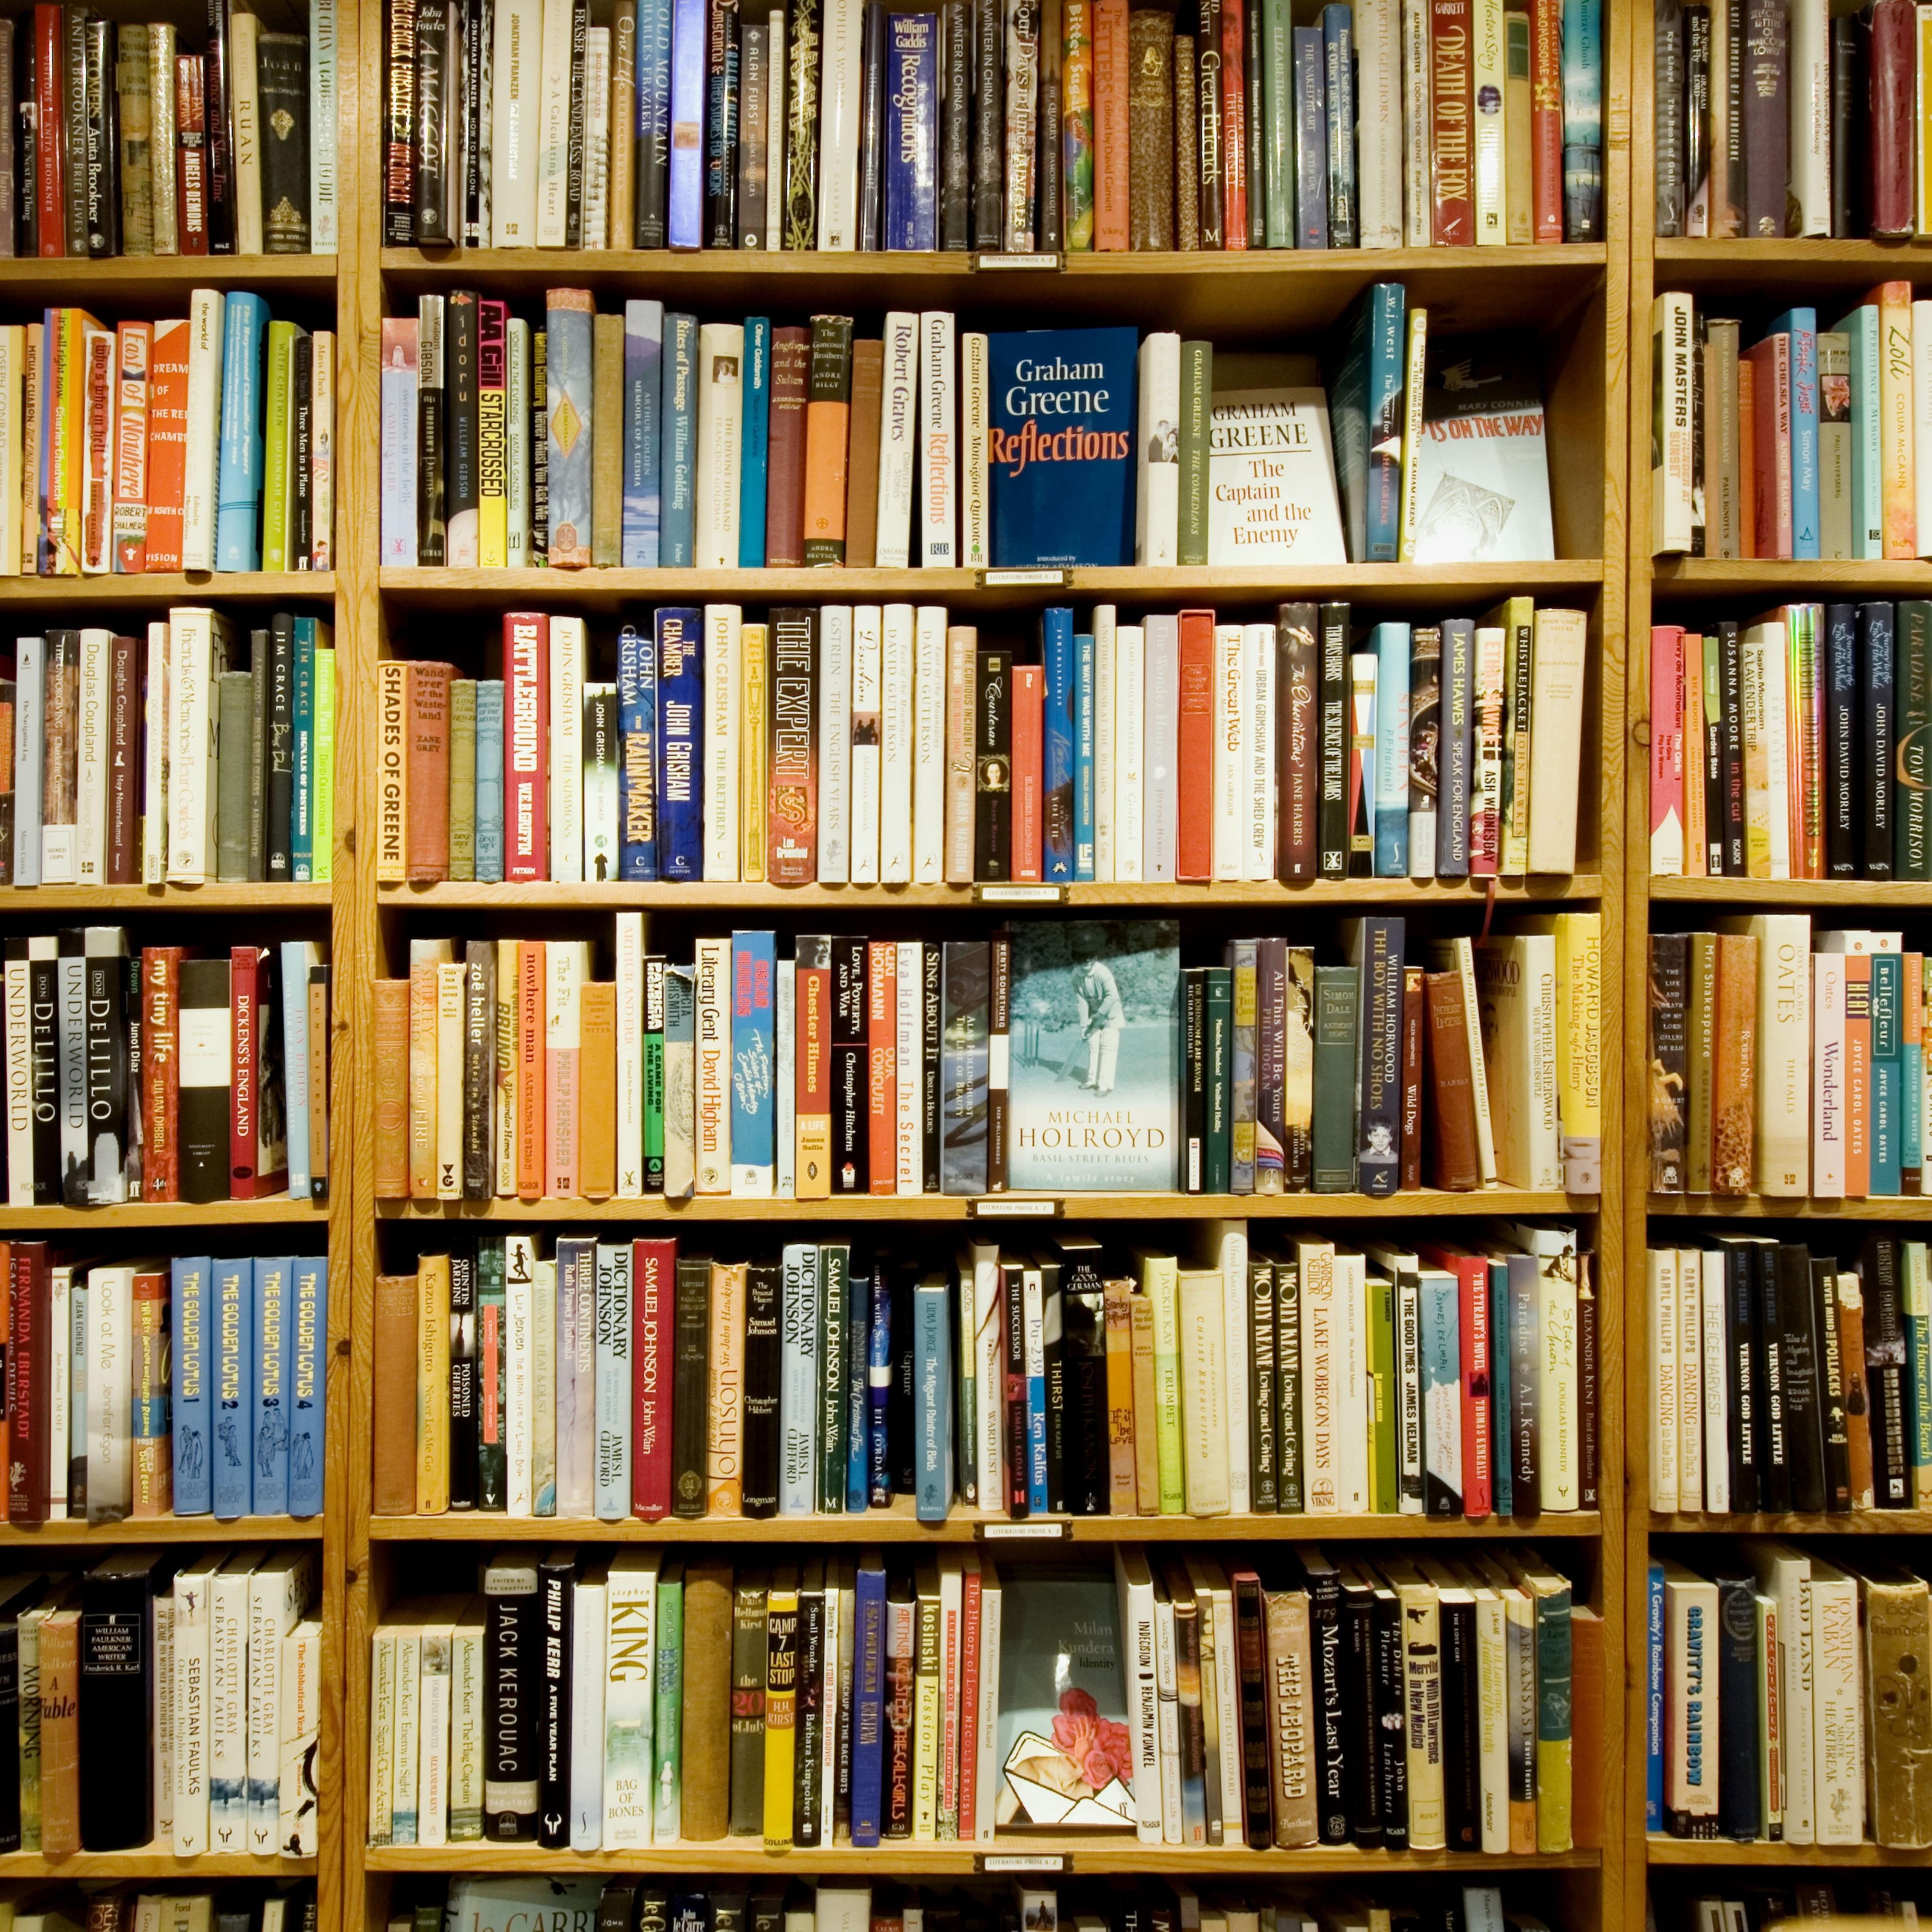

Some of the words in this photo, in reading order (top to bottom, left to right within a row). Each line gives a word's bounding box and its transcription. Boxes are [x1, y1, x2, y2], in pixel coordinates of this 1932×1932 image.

[511, 14, 520, 63] JONATHAN
[894, 22, 929, 35] William
[895, 36, 927, 48] Gaddis
[1069, 4, 1083, 58] Bitter
[1435, 25, 1466, 96] DEATH
[511, 64, 519, 100] FRANZEN
[1069, 64, 1084, 113] Sugar
[1201, 50, 1221, 110] Great
[1436, 102, 1466, 124] OF
[89, 127, 97, 162] Anita
[239, 100, 252, 166] RUAN
[1201, 113, 1221, 185] Friends
[1436, 125, 1467, 157] THE
[184, 151, 200, 187] ANGELS
[1437, 162, 1467, 202] FOX
[89, 164, 102, 223] Brookner
[187, 190, 201, 233] DEMONS
[675, 319, 688, 348] Rites
[1674, 306, 1687, 348] JOHN
[124, 332, 145, 370] East
[676, 349, 688, 361] of
[894, 323, 913, 385] Robert
[1015, 357, 1104, 382] Graham
[123, 384, 144, 407] of
[673, 363, 688, 412] Passage
[1006, 386, 1110, 416] Greene
[1674, 353, 1687, 427] MASTERS
[299, 407, 307, 433] Three
[892, 387, 910, 441] Graves
[1212, 403, 1297, 421] GRAHAM
[481, 393, 503, 498] STARCROSSED
[675, 415, 688, 462] William
[988, 419, 1130, 477] Reflections
[1209, 423, 1308, 449] GREENE
[121, 418, 144, 498] Nowhere
[299, 455, 306, 464] in
[1248, 459, 1284, 478] The
[673, 465, 688, 510] Golding
[1216, 484, 1280, 506] Captain
[114, 521, 146, 532] CHALMERS
[115, 507, 145, 518] ROBERT
[1247, 504, 1279, 523] and
[1283, 503, 1311, 521] the
[1234, 527, 1298, 547] Enemy
[145, 552, 178, 562] VISION
[276, 631, 285, 657] JIM
[682, 640, 695, 657] THE
[777, 617, 811, 672] THE
[1227, 633, 1241, 664] The
[1452, 632, 1466, 675] JAMES
[1727, 631, 1736, 694] SUSANNA
[86, 643, 99, 697] Douglas
[275, 664, 285, 712] CRACE
[1255, 670, 1266, 697] URBAN
[384, 667, 400, 746] SHADES
[513, 624, 538, 772] BATTLEGROUND
[1227, 668, 1241, 714] Great
[1452, 678, 1465, 726] HAWES
[86, 700, 99, 762] Coupland
[666, 700, 690, 736] JOHN
[775, 677, 809, 779] EXPERT
[1227, 717, 1241, 752] Web
[1255, 699, 1266, 753] GRIMSHAW
[1729, 703, 1739, 750] MOORE
[384, 752, 400, 777] OF
[416, 744, 441, 752] GREY
[1255, 756, 1265, 775] AND
[1452, 741, 1464, 776] SPEAK
[1909, 746, 1923, 783] TONI
[666, 742, 692, 802] GRISHAM
[1254, 779, 1265, 794] THE
[1452, 779, 1463, 799] FOR
[384, 784, 399, 860] GREENE
[1254, 797, 1265, 820] SHED
[1253, 823, 1264, 848] CREW
[1452, 801, 1463, 862] ENGLAND
[1909, 789, 1924, 870] MORRISON
[150, 960, 166, 987] my
[525, 953, 536, 1024] nowhere
[699, 946, 720, 1004] Literary
[1777, 943, 1796, 1024] OATES
[150, 991, 169, 1026] tiny
[702, 1007, 720, 1042] Gent
[808, 976, 821, 1038] Chester
[9, 968, 29, 1132] UNDERWORLD
[157, 1031, 174, 1063] life
[525, 1029, 535, 1064] man
[702, 1050, 720, 1092] David
[808, 1042, 821, 1093] Himes
[1407, 1084, 1417, 1109] Wild
[1823, 1040, 1839, 1142] Wonderland
[700, 1094, 721, 1152] Higham
[1049, 1110, 1135, 1123] MICHAEL
[1404, 1111, 1416, 1136] Dogs
[1019, 1128, 1165, 1148] HOLROYD
[1033, 1154, 1064, 1163] BASIL
[1069, 1154, 1110, 1163] STREET
[1115, 1154, 1149, 1163] BLUES
[183, 1272, 200, 1299] THE
[452, 1259, 461, 1306] JARDINE
[461, 1259, 469, 1305] QUINTIN
[1067, 1282, 1101, 1291] GERMAN
[1072, 1273, 1097, 1283] GOOD
[1077, 1264, 1091, 1274] THE
[102, 1280, 116, 1317] Look
[1403, 1298, 1414, 1319] THE
[102, 1323, 116, 1335] at
[183, 1301, 200, 1351] GOLDEN
[1404, 1322, 1414, 1347] GOOD
[101, 1343, 115, 1370] Me
[183, 1352, 200, 1397] LOTUS
[1406, 1350, 1414, 1374] TIMES
[1740, 1343, 1751, 1391] VERNON
[453, 1365, 461, 1417] CHERRIES
[462, 1363, 470, 1418] POISONED
[1406, 1383, 1416, 1418] JAMES
[1741, 1395, 1750, 1419] GOD
[1406, 1422, 1416, 1463] KELMAN
[1741, 1423, 1751, 1465] LITTLE
[742, 1495, 776, 1505] Longman
[499, 1604, 518, 1657] JACK
[609, 1599, 650, 1682] KING
[769, 1618, 796, 1635] CAMP
[778, 1635, 787, 1651] 7
[922, 1604, 938, 1671] kosinski
[1139, 1622, 1151, 1667] INDECISION
[770, 1651, 794, 1667] LAST
[1321, 1624, 1340, 1707] Mozart's
[1686, 1606, 1703, 1696] GRAVITY'S
[770, 1669, 795, 1684] STOP
[1275, 1653, 1300, 1697] THE
[188, 1657, 200, 1736] SEBASTIAN
[1140, 1685, 1154, 1729] BENJAMIN
[499, 1668, 518, 1772] KEROUAC
[1326, 1711, 1342, 1749] Last
[1142, 1733, 1155, 1768] KUNKEL
[1279, 1698, 1308, 1799] LEOPARD
[1686, 1702, 1703, 1787] RAINBOW
[189, 1741, 200, 1795] FAULKS
[616, 1779, 637, 1791] BAG
[1327, 1752, 1344, 1798] Year
[609, 1806, 644, 1818] BONES
[619, 1793, 633, 1803] OF
